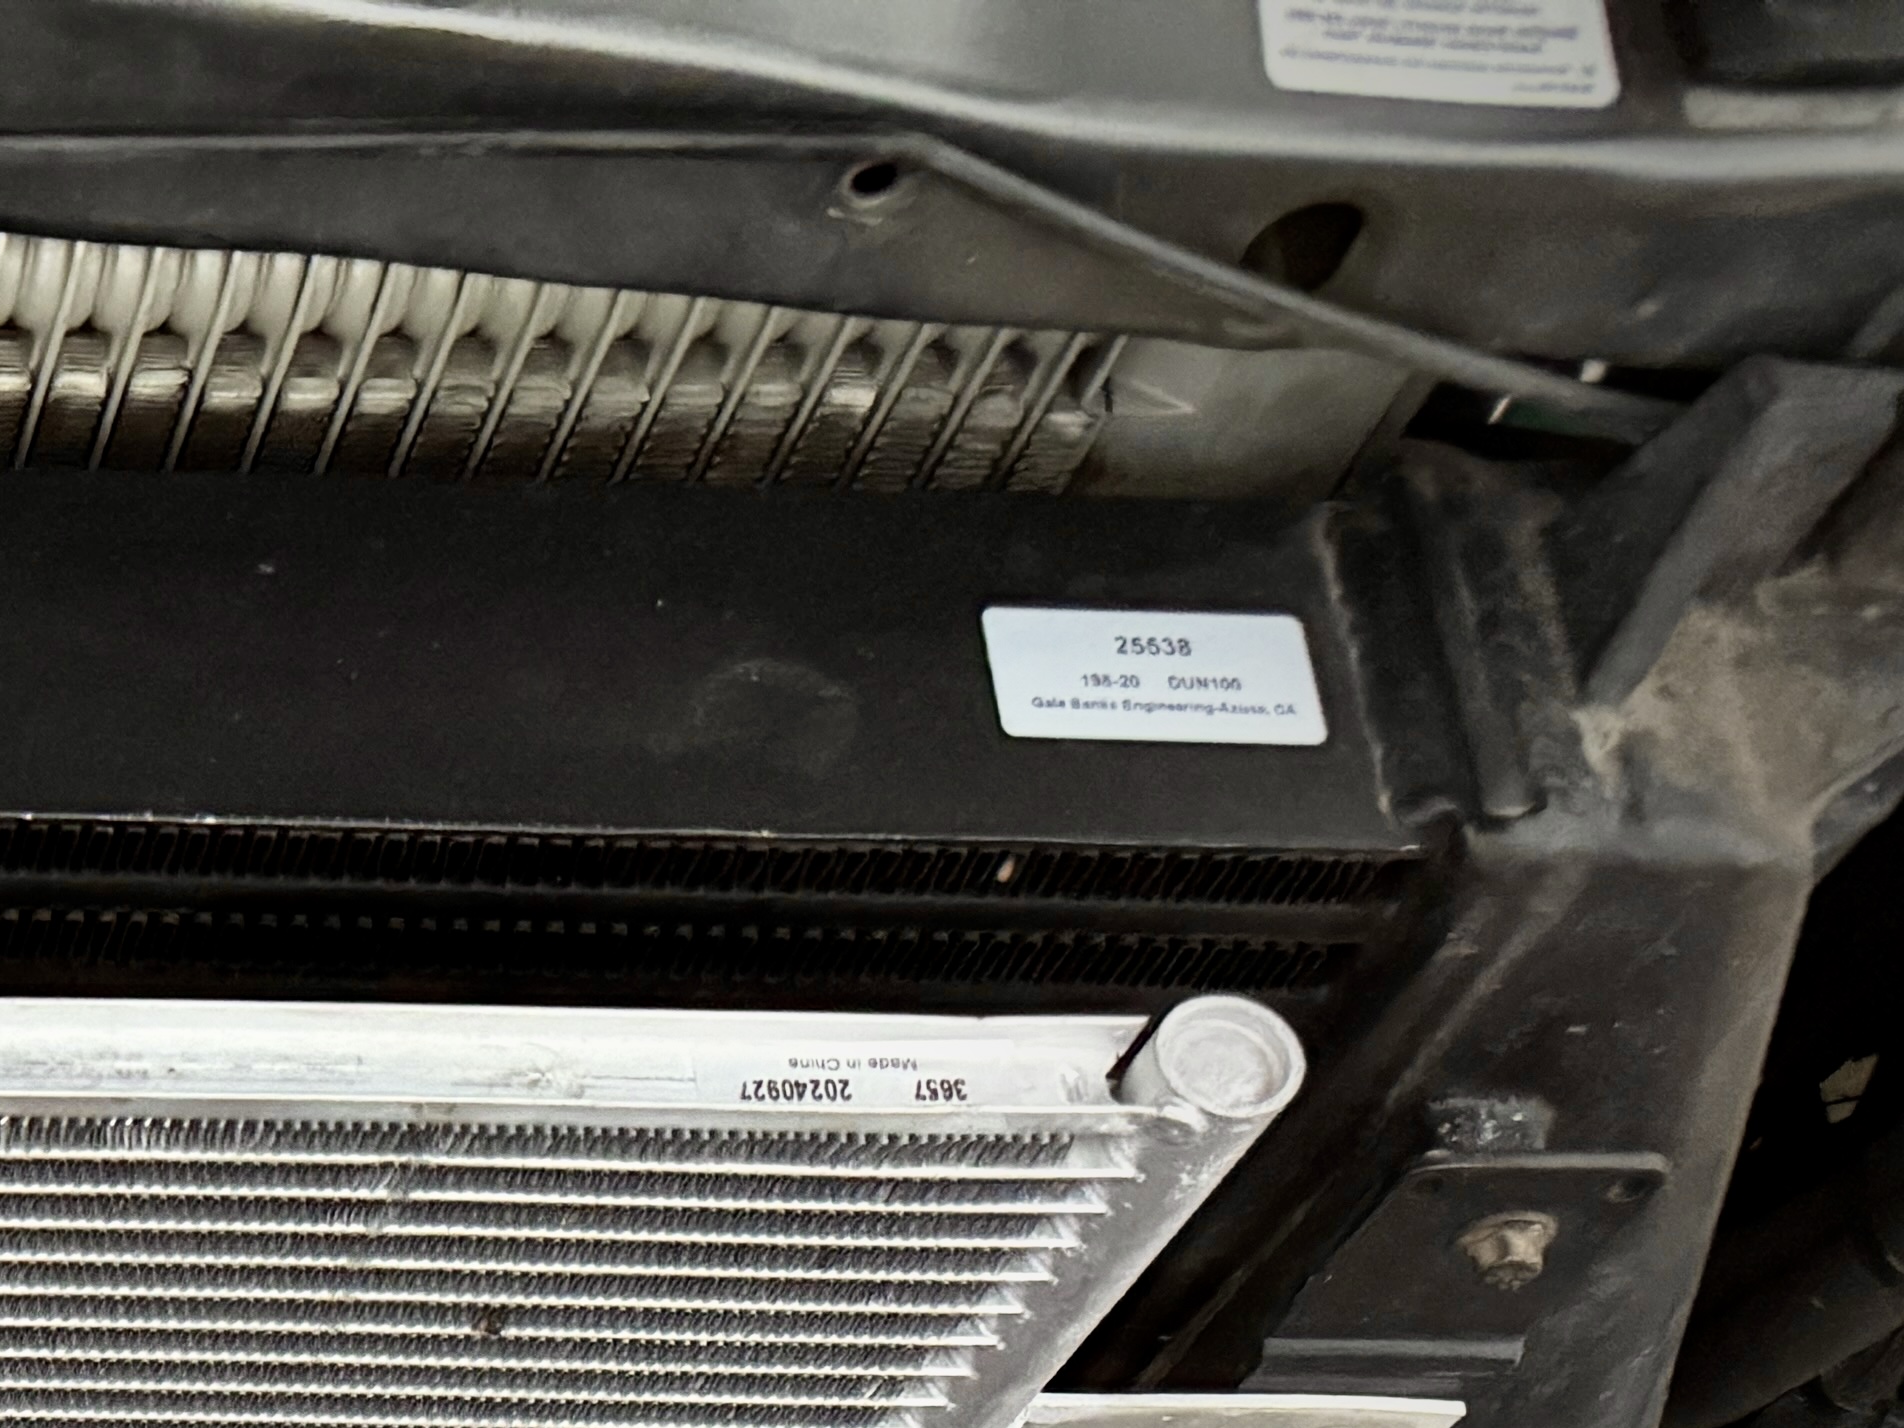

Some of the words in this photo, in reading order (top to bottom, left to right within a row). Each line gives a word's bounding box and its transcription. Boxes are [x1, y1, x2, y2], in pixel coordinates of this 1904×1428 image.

[846, 1057, 862, 1072] in
[868, 1056, 918, 1073] Made
[740, 1078, 853, 1102] 20240927
